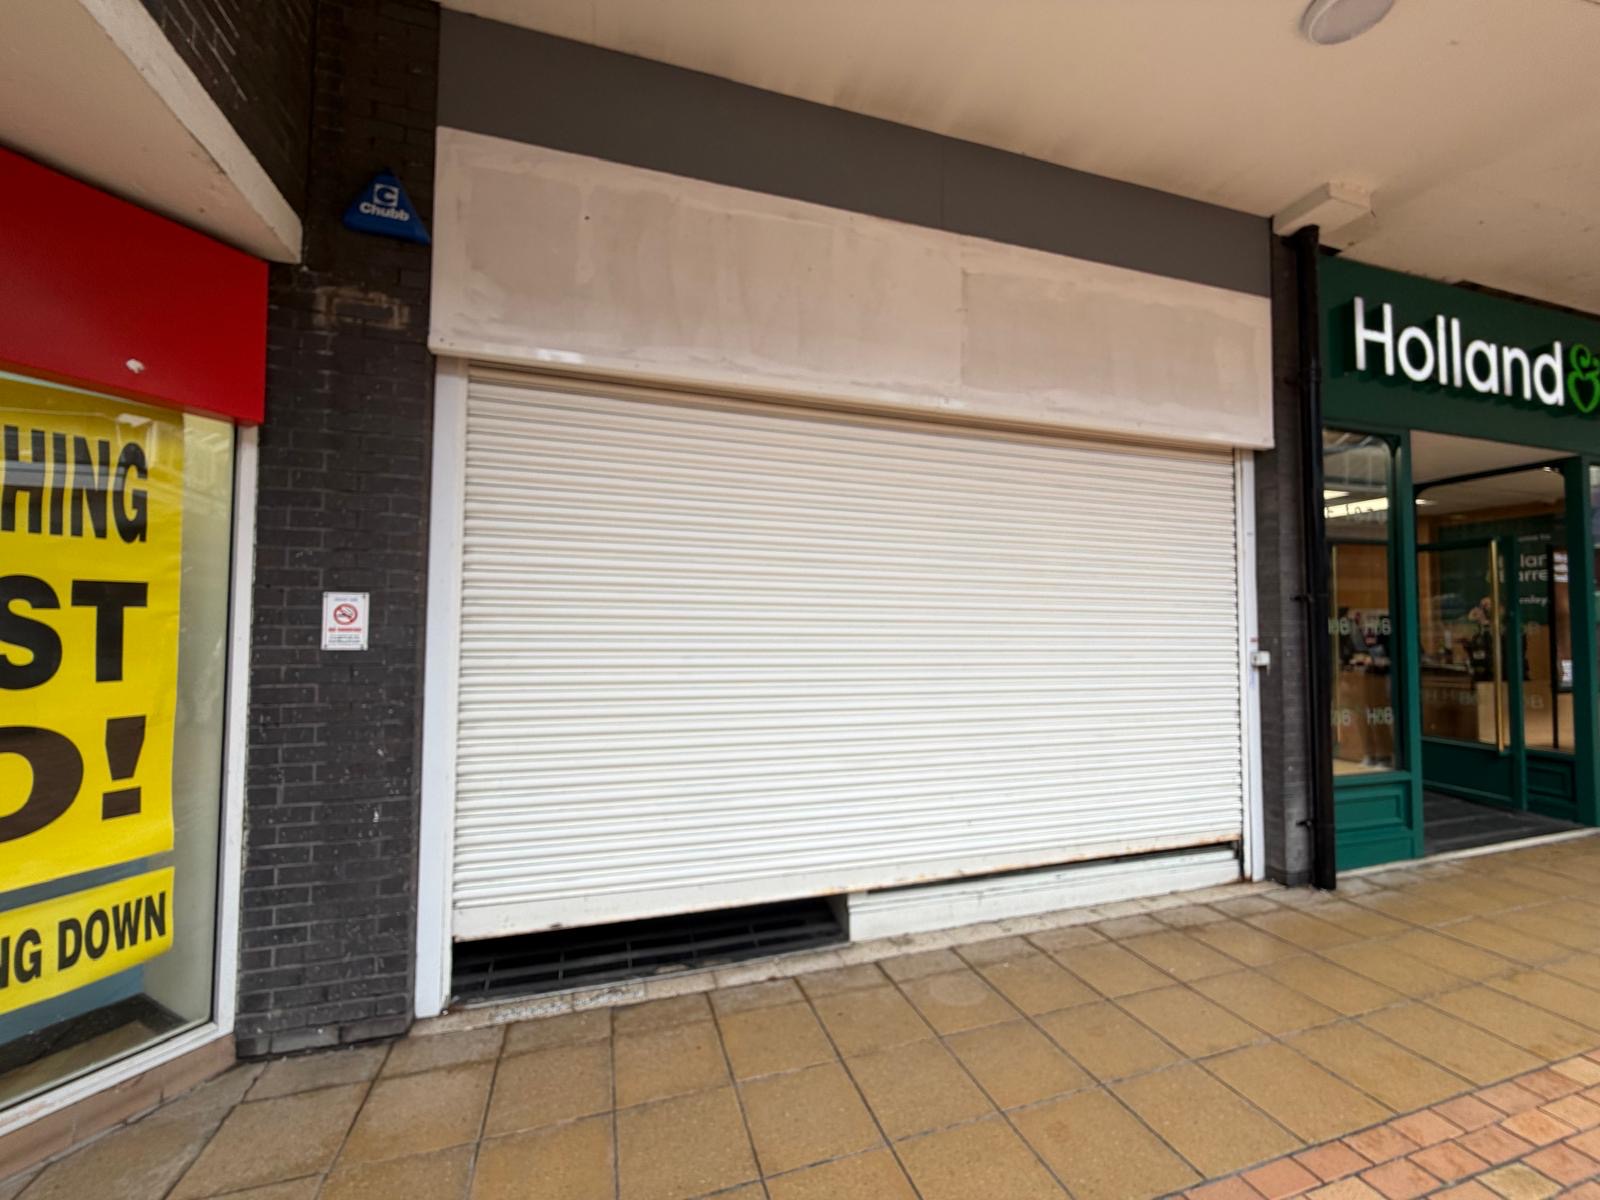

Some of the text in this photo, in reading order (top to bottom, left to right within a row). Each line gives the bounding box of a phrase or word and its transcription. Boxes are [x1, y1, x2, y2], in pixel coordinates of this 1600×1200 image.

[1354, 296, 1565, 406] Holland
[1, 425, 148, 543] HING
[57, 891, 166, 971] DOWN
